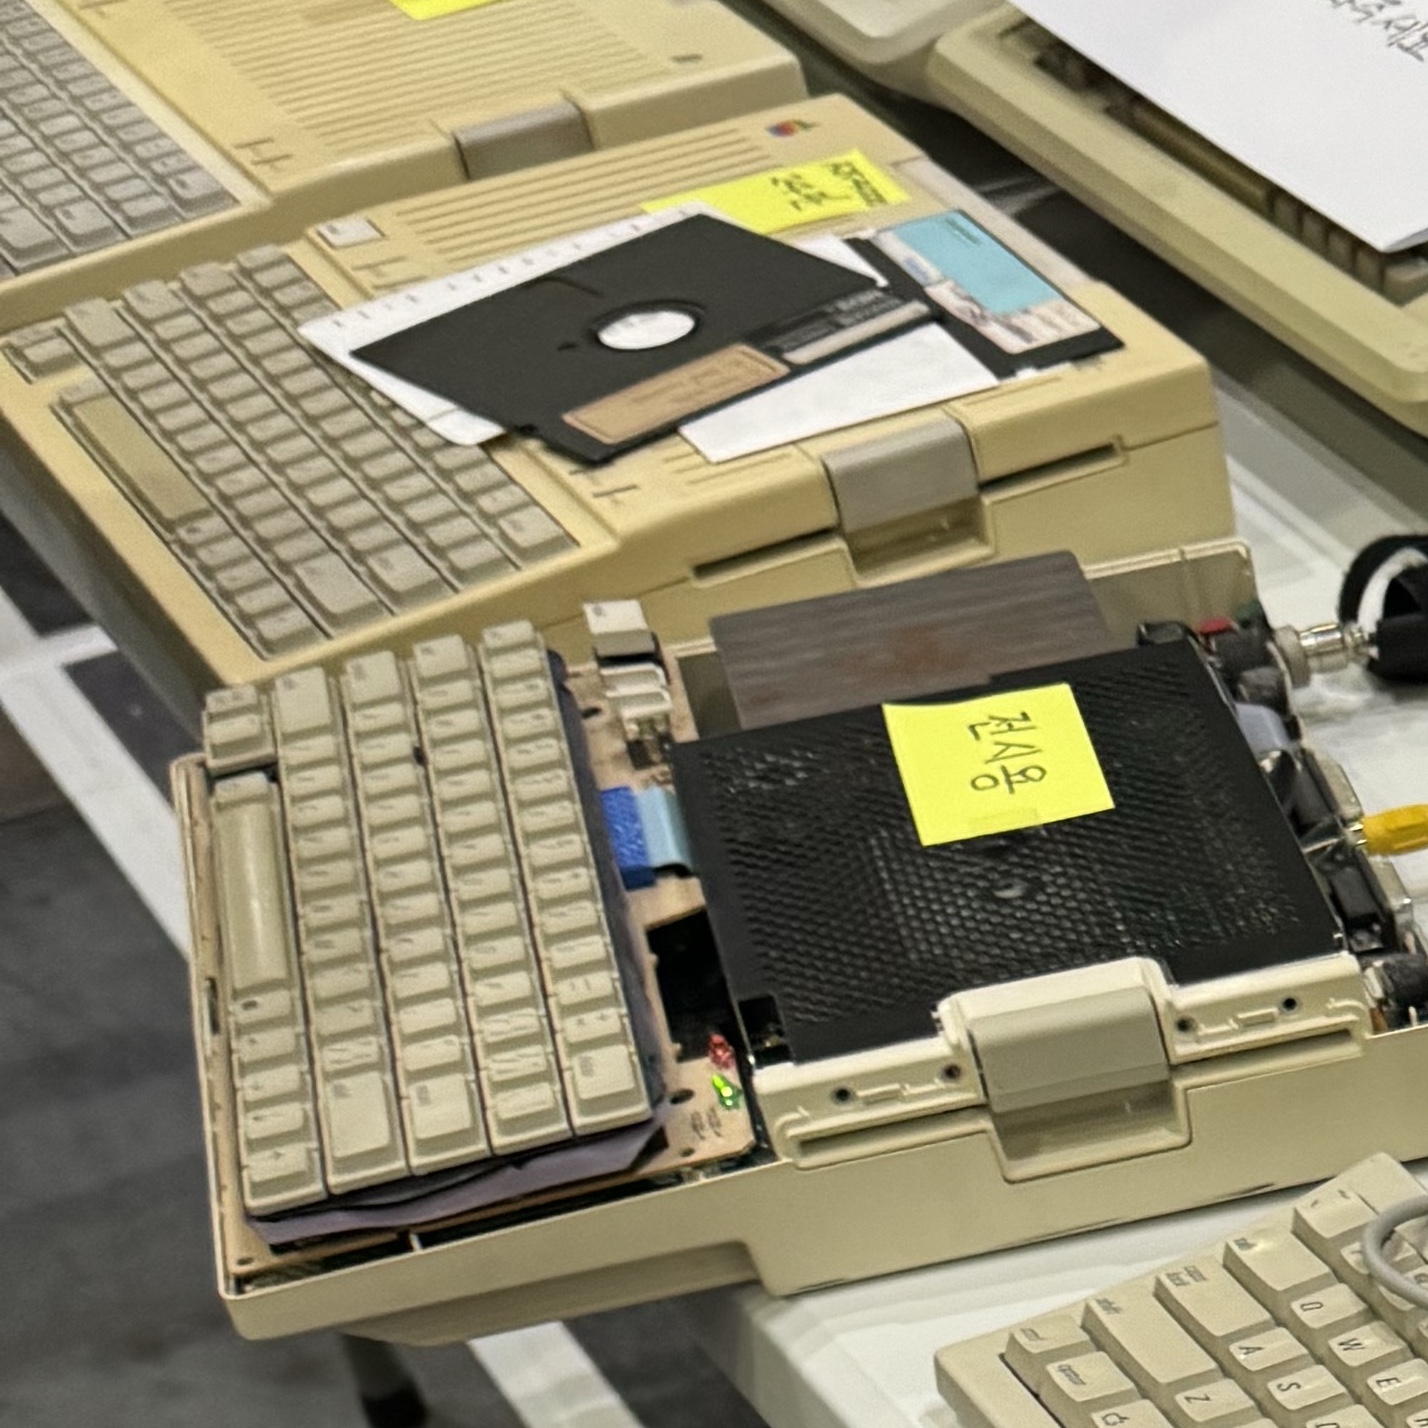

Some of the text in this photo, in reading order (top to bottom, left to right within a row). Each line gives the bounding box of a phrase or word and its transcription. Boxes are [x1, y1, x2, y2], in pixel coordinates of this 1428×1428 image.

[967, 711, 1048, 796] 전시용
[1337, 1337, 1366, 1352] W
[1238, 1345, 1265, 1359] A
[1276, 1381, 1302, 1393] S
[1375, 1376, 1403, 1388] E
[1183, 1393, 1212, 1404] Z
